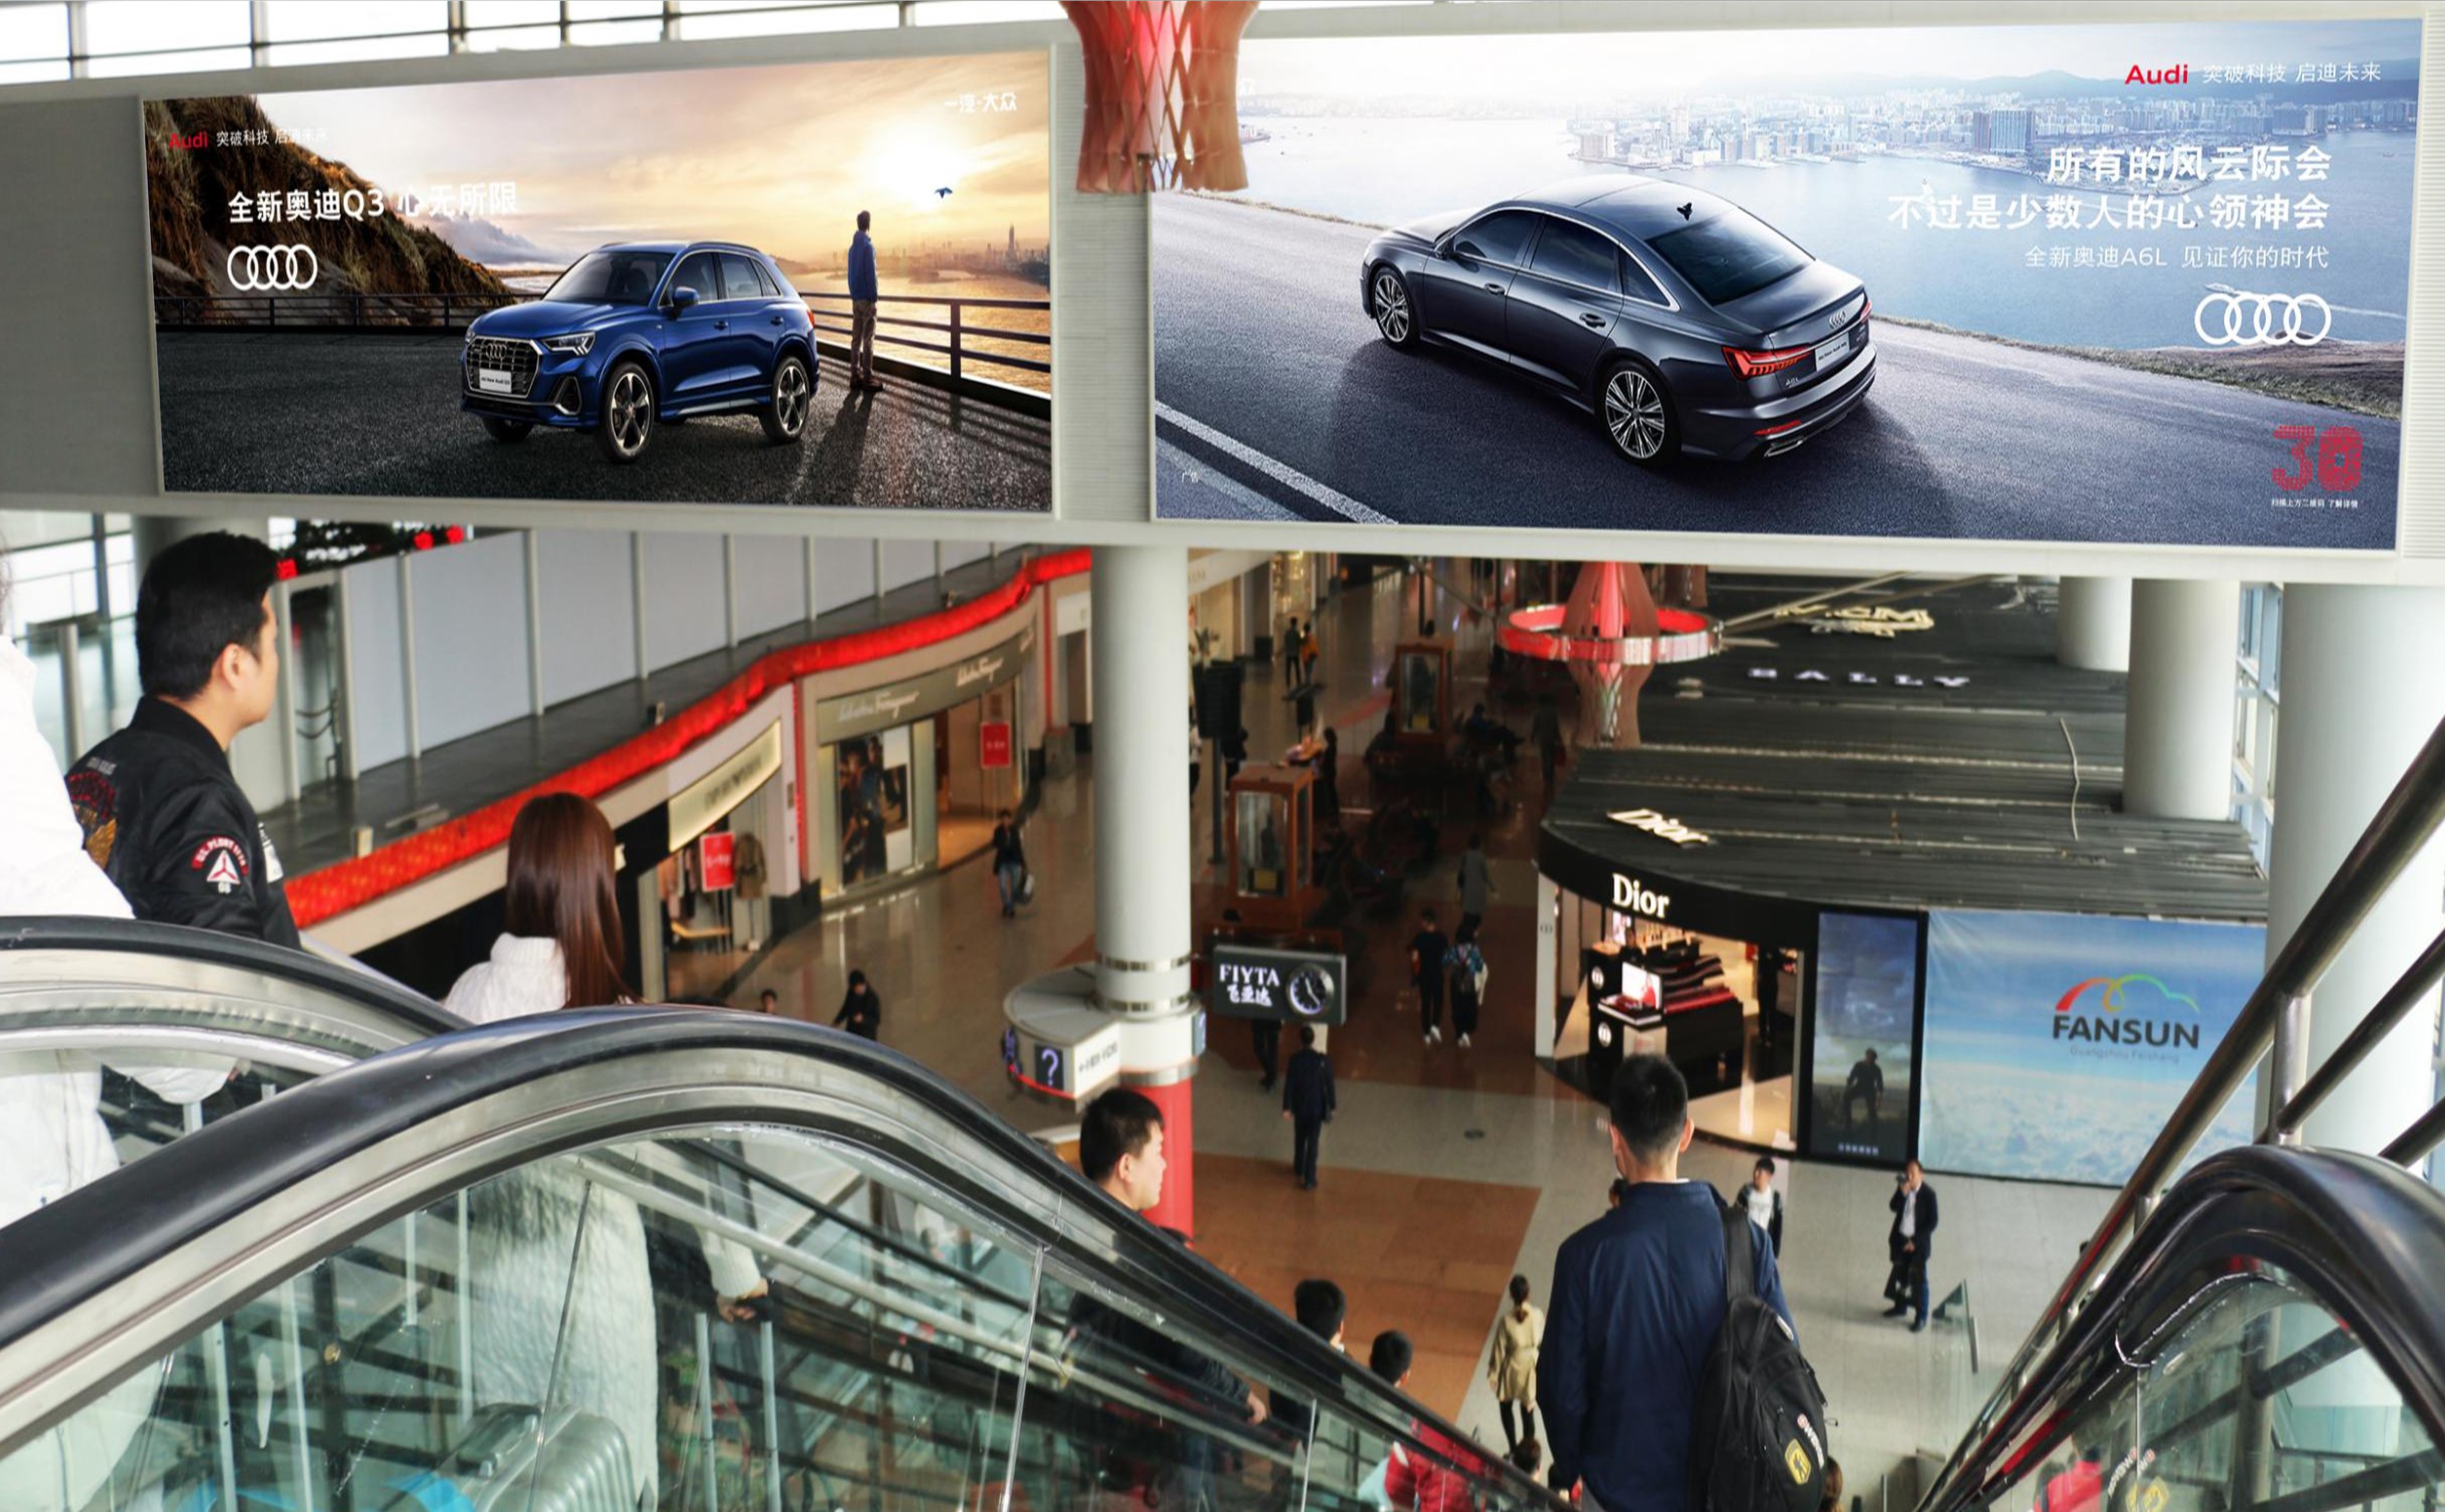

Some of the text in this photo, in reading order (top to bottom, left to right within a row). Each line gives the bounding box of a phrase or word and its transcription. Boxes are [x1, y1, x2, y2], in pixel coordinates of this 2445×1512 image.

[2124, 64, 2189, 85] Audi
[2203, 61, 2381, 84] 突破科技 启迪未来
[169, 132, 208, 149] Audi
[216, 129, 269, 148] 突破科技
[2047, 144, 2333, 183] 所有的风云际会
[228, 180, 518, 224] 全新奥迪Q3 心无所限
[1886, 193, 2330, 231] 不过是少数人的心领神会
[2025, 245, 2329, 268] 全新奥迪A6L 见证你的时代
[1748, 668, 1970, 687] BALLY
[1607, 808, 1709, 844] Dior
[1613, 872, 1670, 918] Dior
[1219, 963, 1280, 987] FIYTA
[2052, 1014, 2200, 1050] FANSUN
